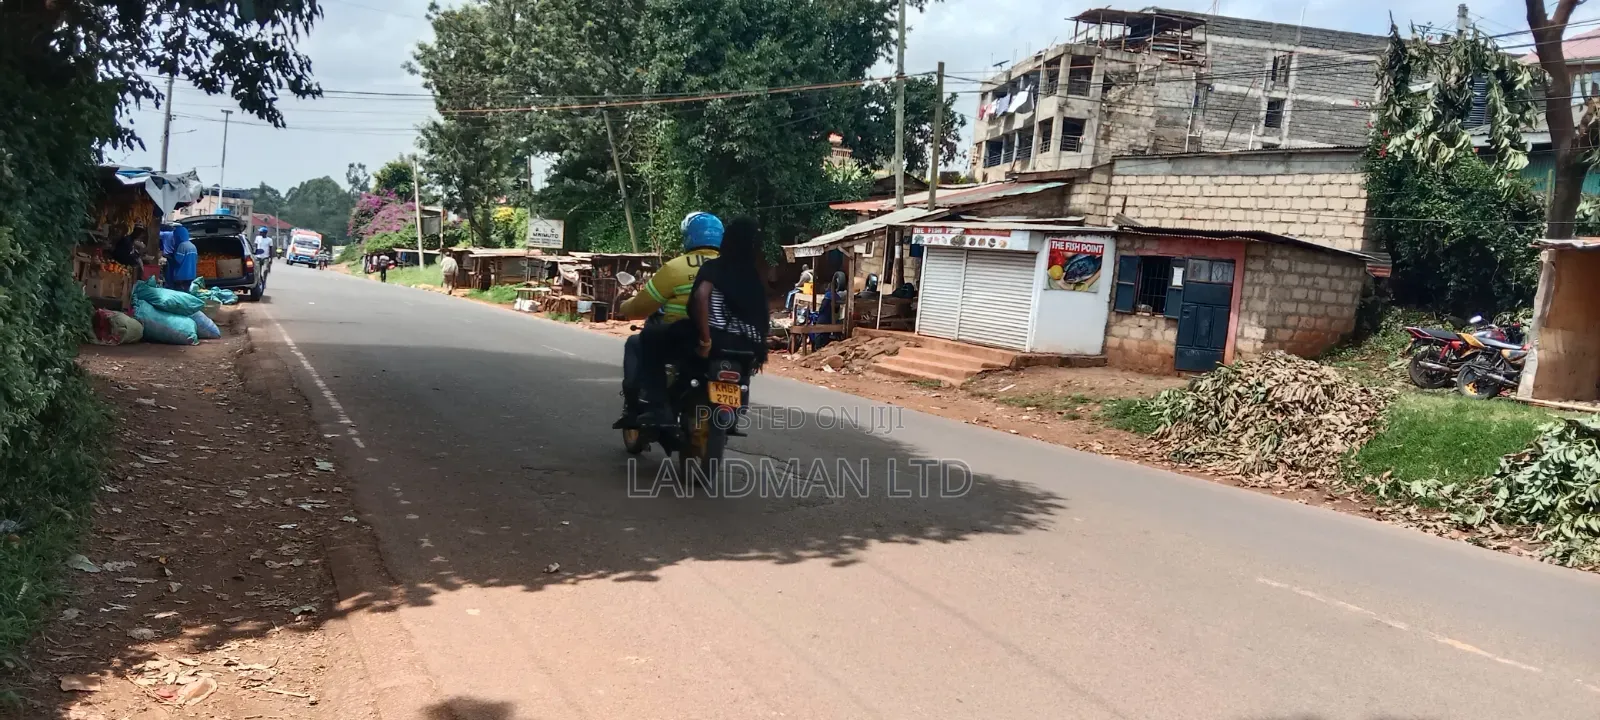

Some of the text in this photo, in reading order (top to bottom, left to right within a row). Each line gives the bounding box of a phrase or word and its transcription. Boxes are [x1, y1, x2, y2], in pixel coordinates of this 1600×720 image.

[1051, 240, 1103, 254] THE FISH POINT
[716, 394, 739, 406] 270X
